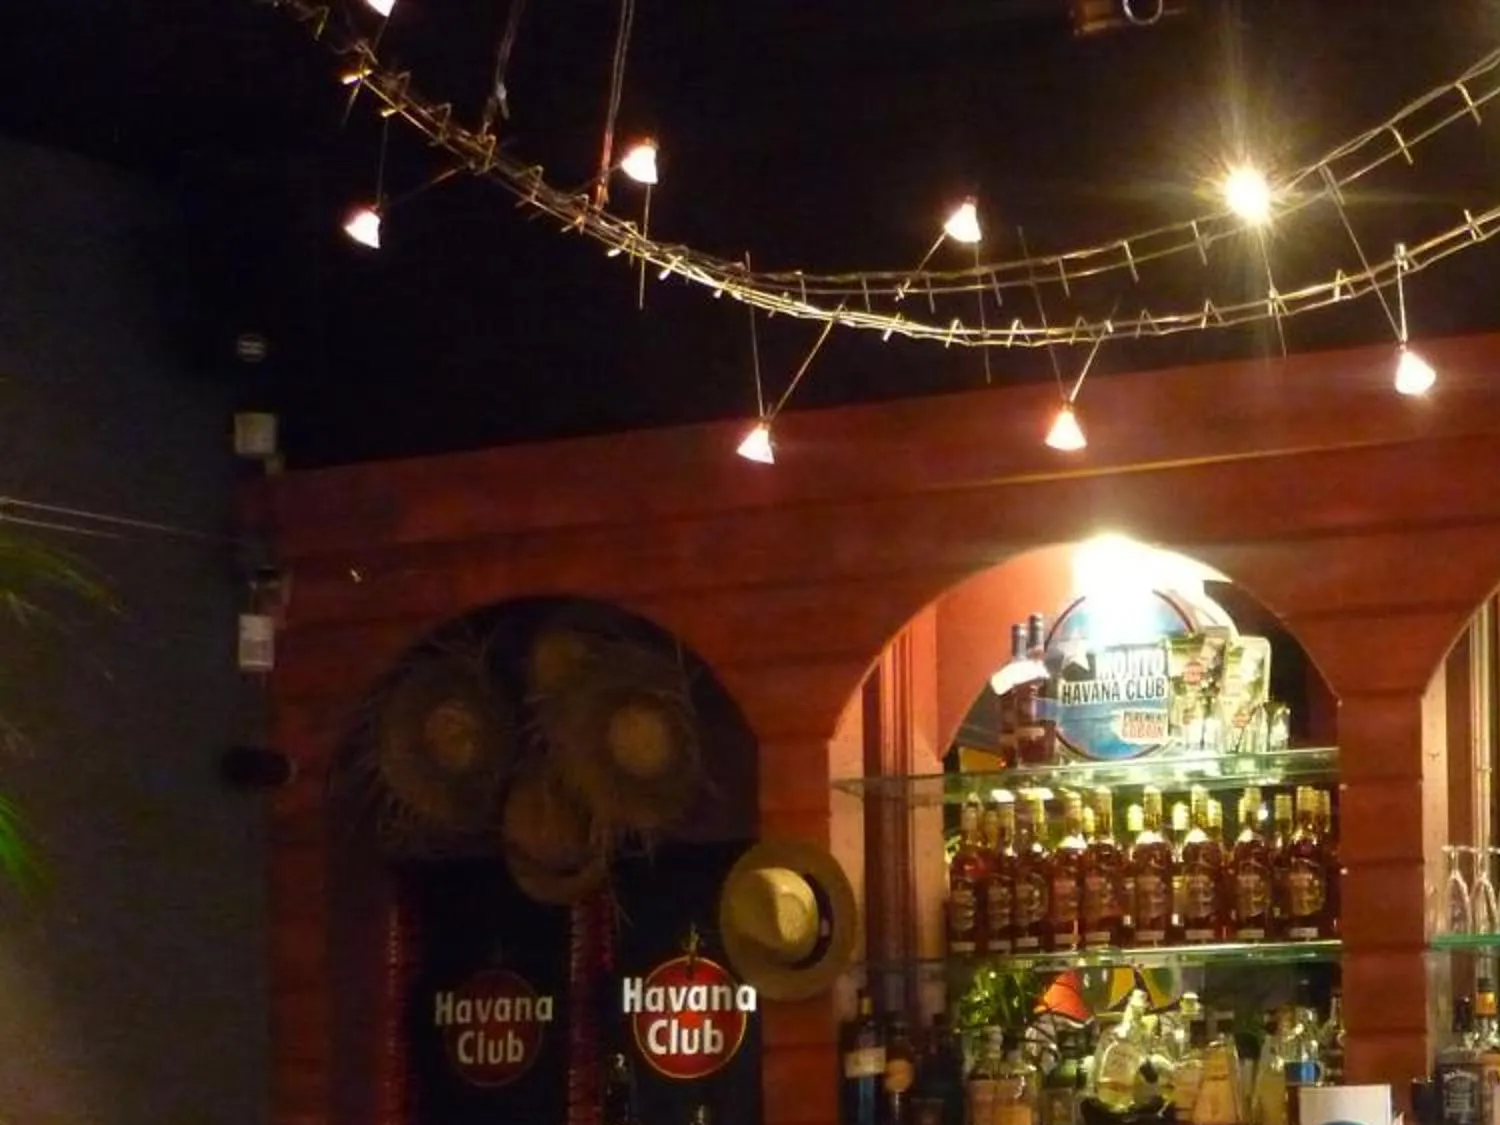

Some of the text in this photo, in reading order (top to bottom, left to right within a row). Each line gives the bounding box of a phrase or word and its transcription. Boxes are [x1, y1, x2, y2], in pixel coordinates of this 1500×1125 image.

[1062, 677, 1165, 704] HAVANA CLUB
[434, 991, 554, 1025] Havana
[622, 976, 758, 1013] Havana
[456, 1030, 525, 1065] Club
[647, 1019, 725, 1054] Club
